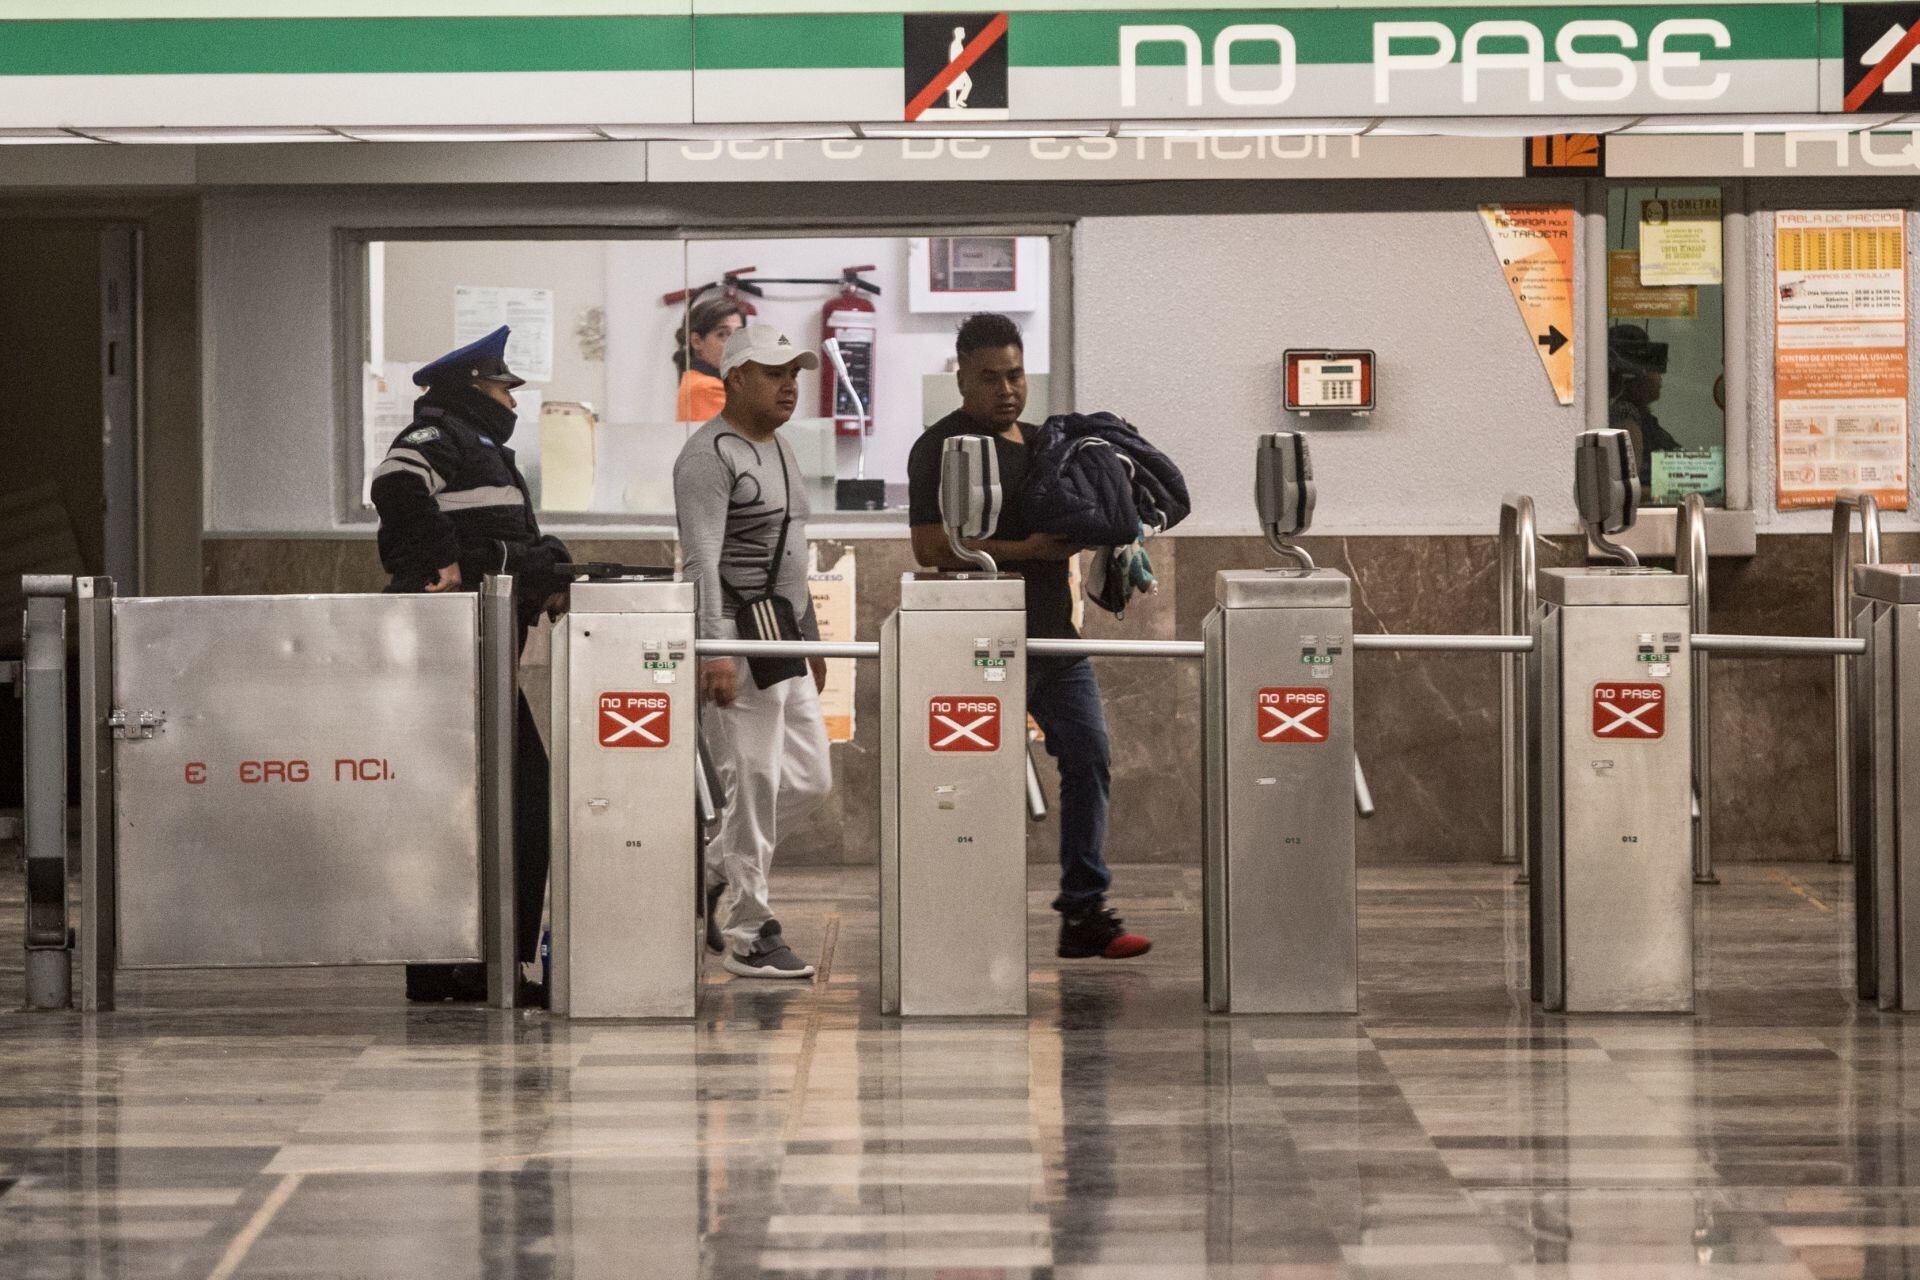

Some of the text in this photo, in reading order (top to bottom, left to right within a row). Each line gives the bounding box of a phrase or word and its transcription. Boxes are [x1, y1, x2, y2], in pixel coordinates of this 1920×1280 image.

[1119, 18, 1732, 107] NO PASE
[1670, 199, 1717, 209] COMETRA
[1779, 212, 1900, 224] TABLA DE PRECIOS
[1513, 230, 1568, 239] TARJETA
[1810, 354, 1821, 362] DE
[1859, 353, 1869, 361] AL
[1870, 352, 1903, 360] USUARIO
[1259, 693, 1326, 704] NO PASE
[1594, 688, 1662, 699] NO PASE
[601, 698, 668, 709] NO PASE
[931, 702, 997, 713] NO PASE
[1622, 835, 1638, 843] 012
